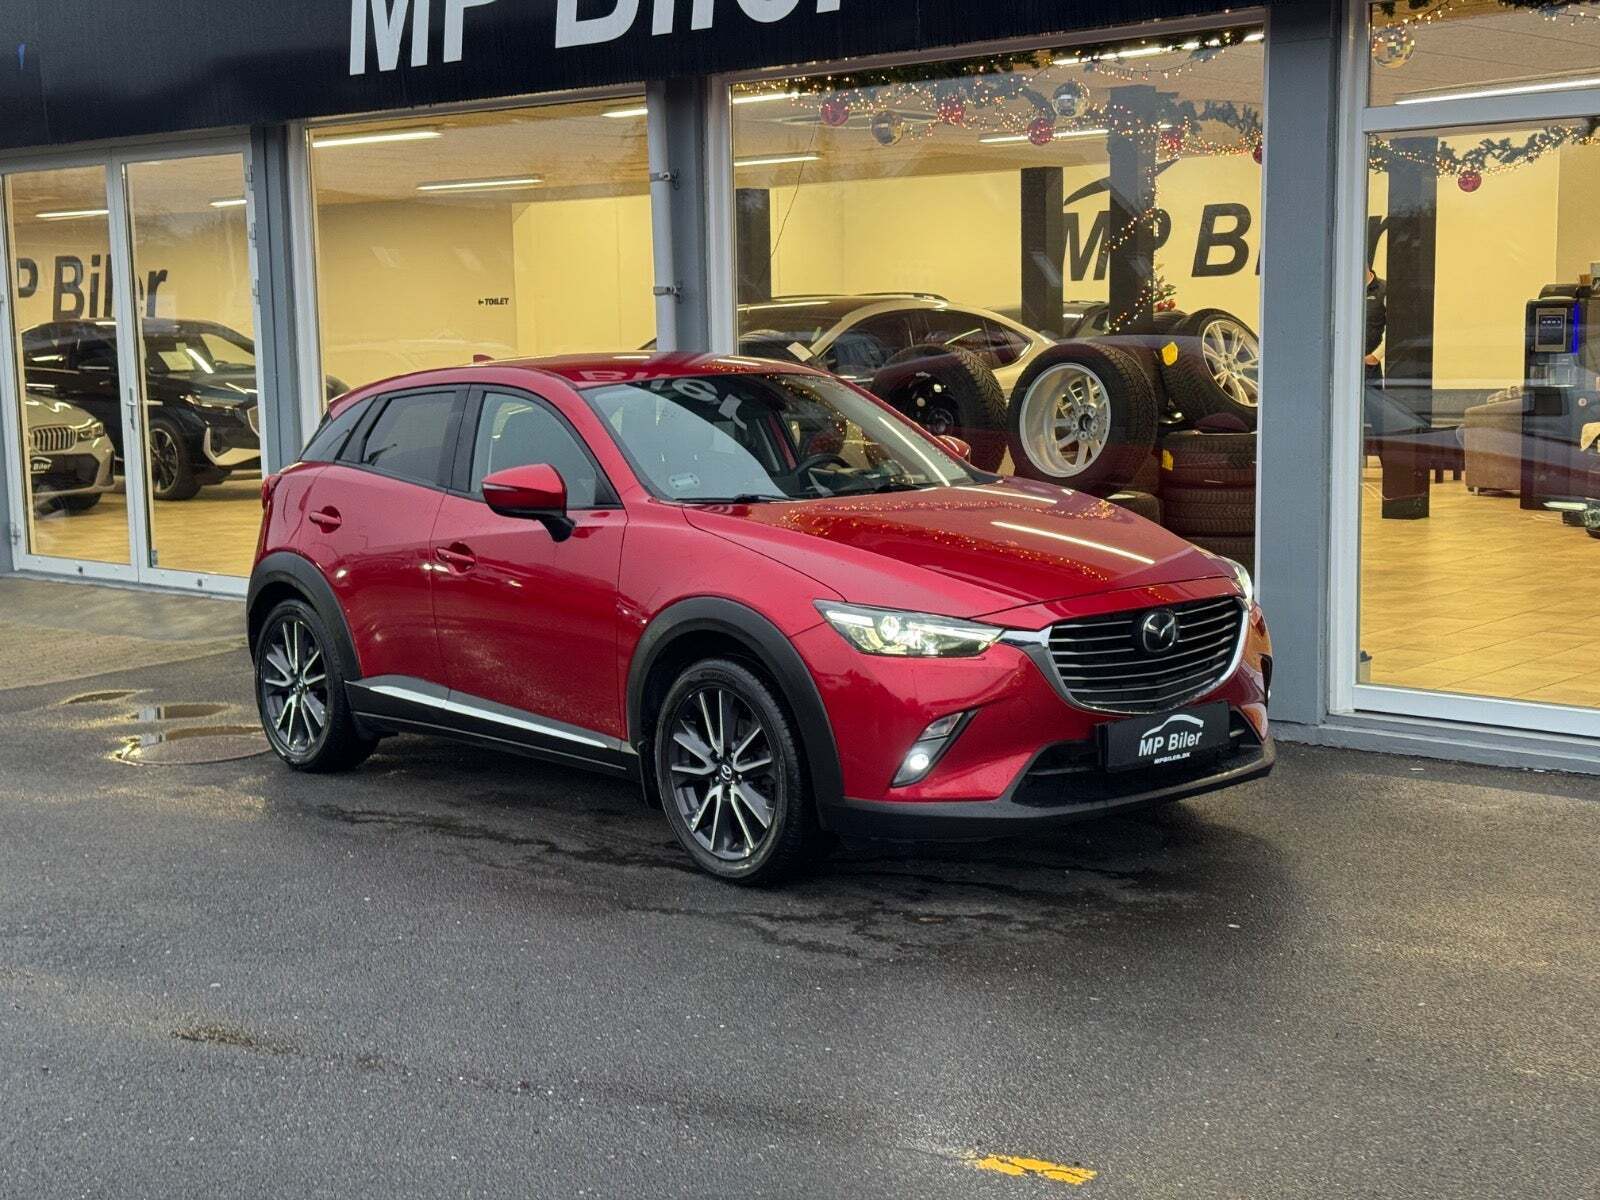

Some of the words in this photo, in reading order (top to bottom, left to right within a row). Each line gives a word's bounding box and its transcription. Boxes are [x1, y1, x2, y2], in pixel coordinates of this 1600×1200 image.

[53, 254, 168, 321] Bilr
[485, 297, 509, 306] TOILET
[1138, 736, 1164, 757] MP
[1167, 731, 1202, 751] Biler
